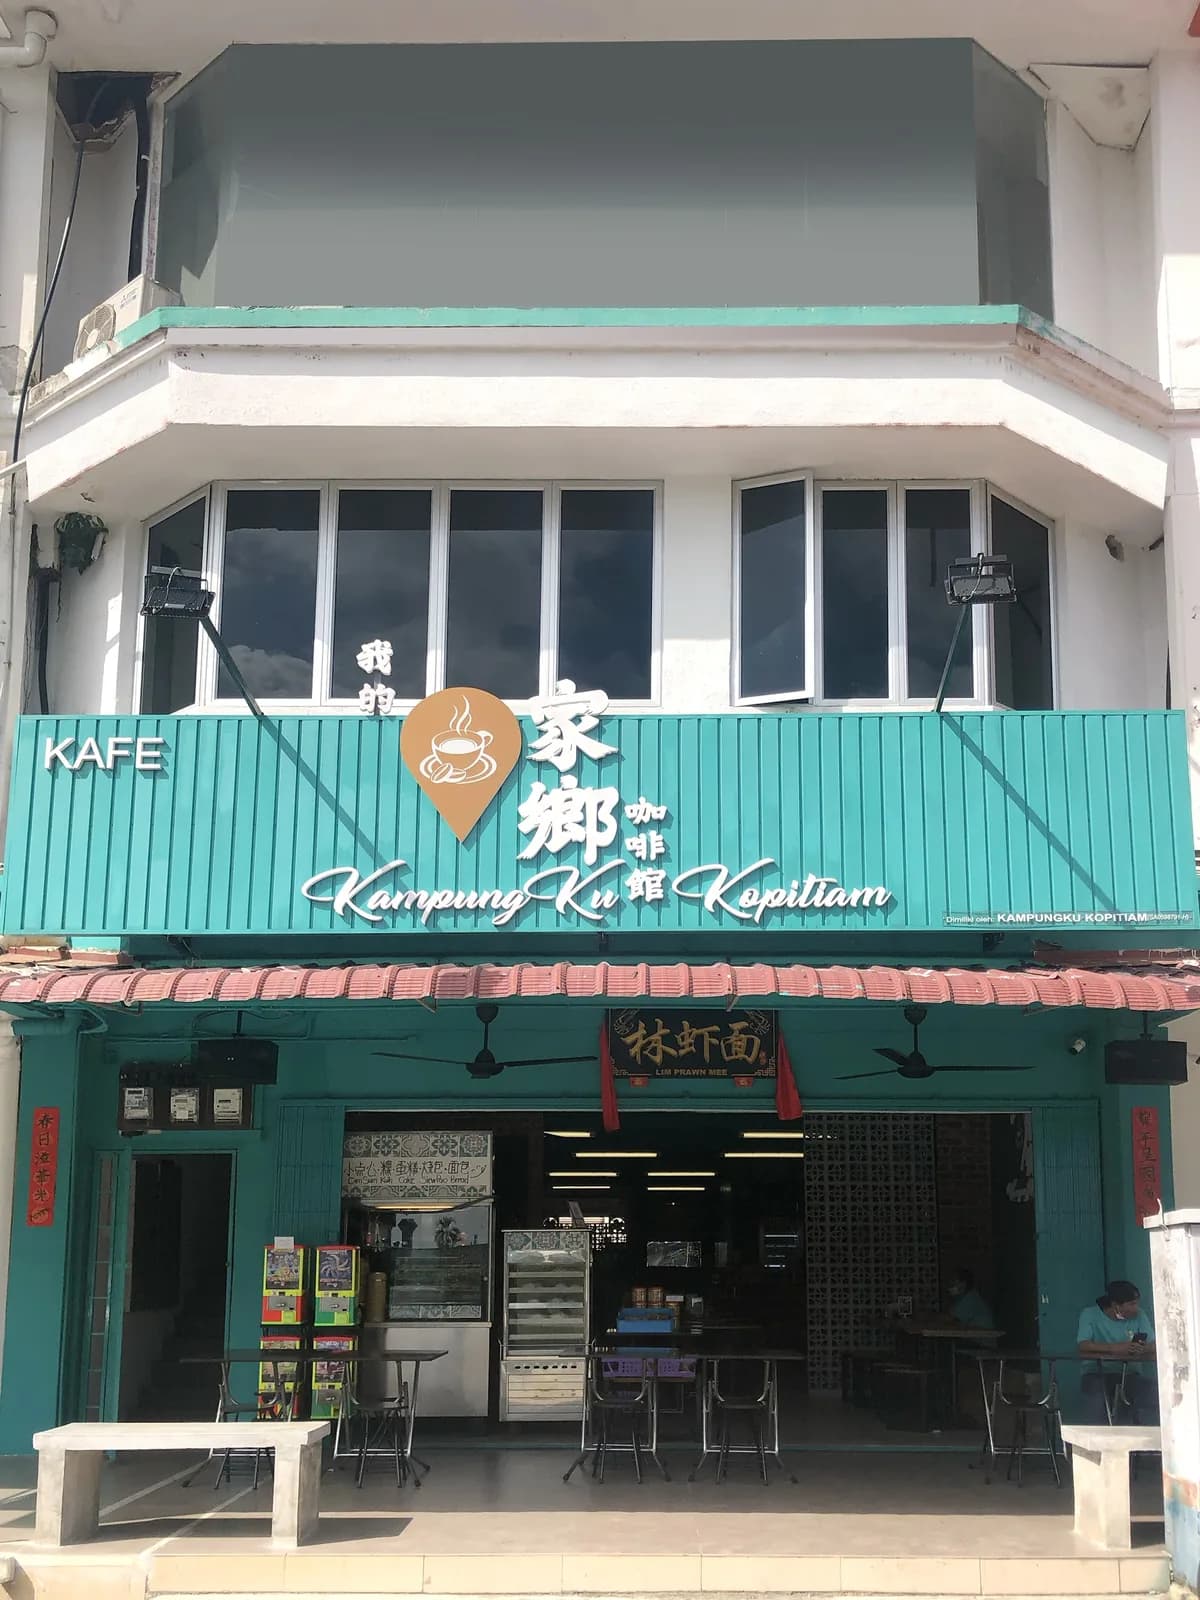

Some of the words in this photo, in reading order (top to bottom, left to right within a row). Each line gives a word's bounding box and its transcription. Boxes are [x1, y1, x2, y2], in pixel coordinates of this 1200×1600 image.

[356, 639, 396, 714] 我的
[44, 737, 165, 770] KAFE
[517, 679, 619, 866] 家鄉
[624, 797, 667, 902] 咖啡館
[672, 857, 891, 924] Kopitiam
[997, 913, 1081, 922] KAMPUNGKU
[1084, 913, 1147, 922] KOPITIAM
[621, 1018, 761, 1066] 林虾面
[655, 1068, 672, 1076] LIM
[673, 1068, 706, 1076] PRAWN
[708, 1068, 728, 1076] MEE
